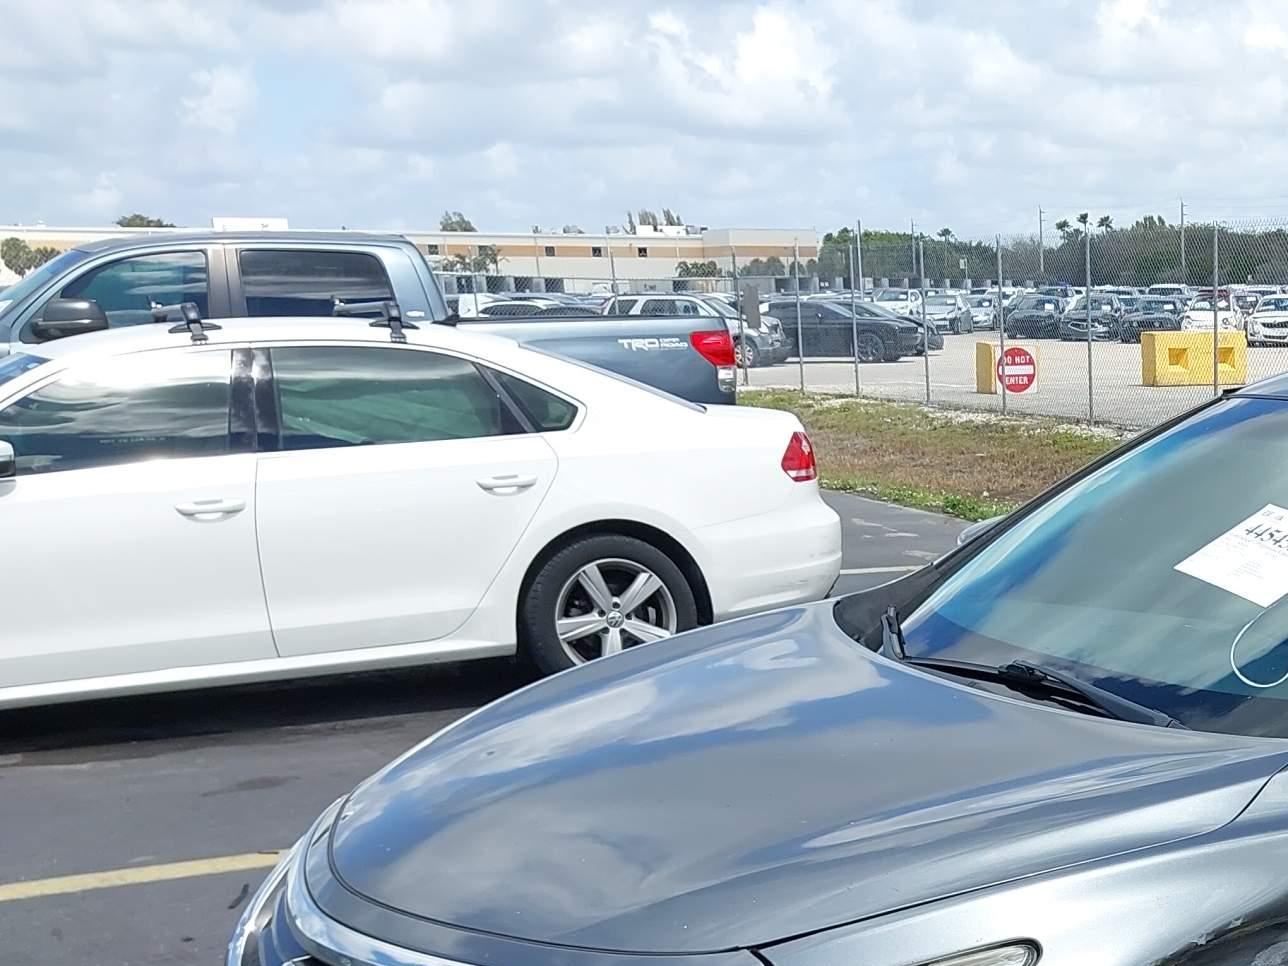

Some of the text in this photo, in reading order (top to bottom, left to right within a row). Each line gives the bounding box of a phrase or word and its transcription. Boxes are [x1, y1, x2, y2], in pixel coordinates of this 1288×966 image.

[617, 338, 660, 352] TRD
[1015, 356, 1031, 364] NOT
[1005, 376, 1029, 385] ENTER
